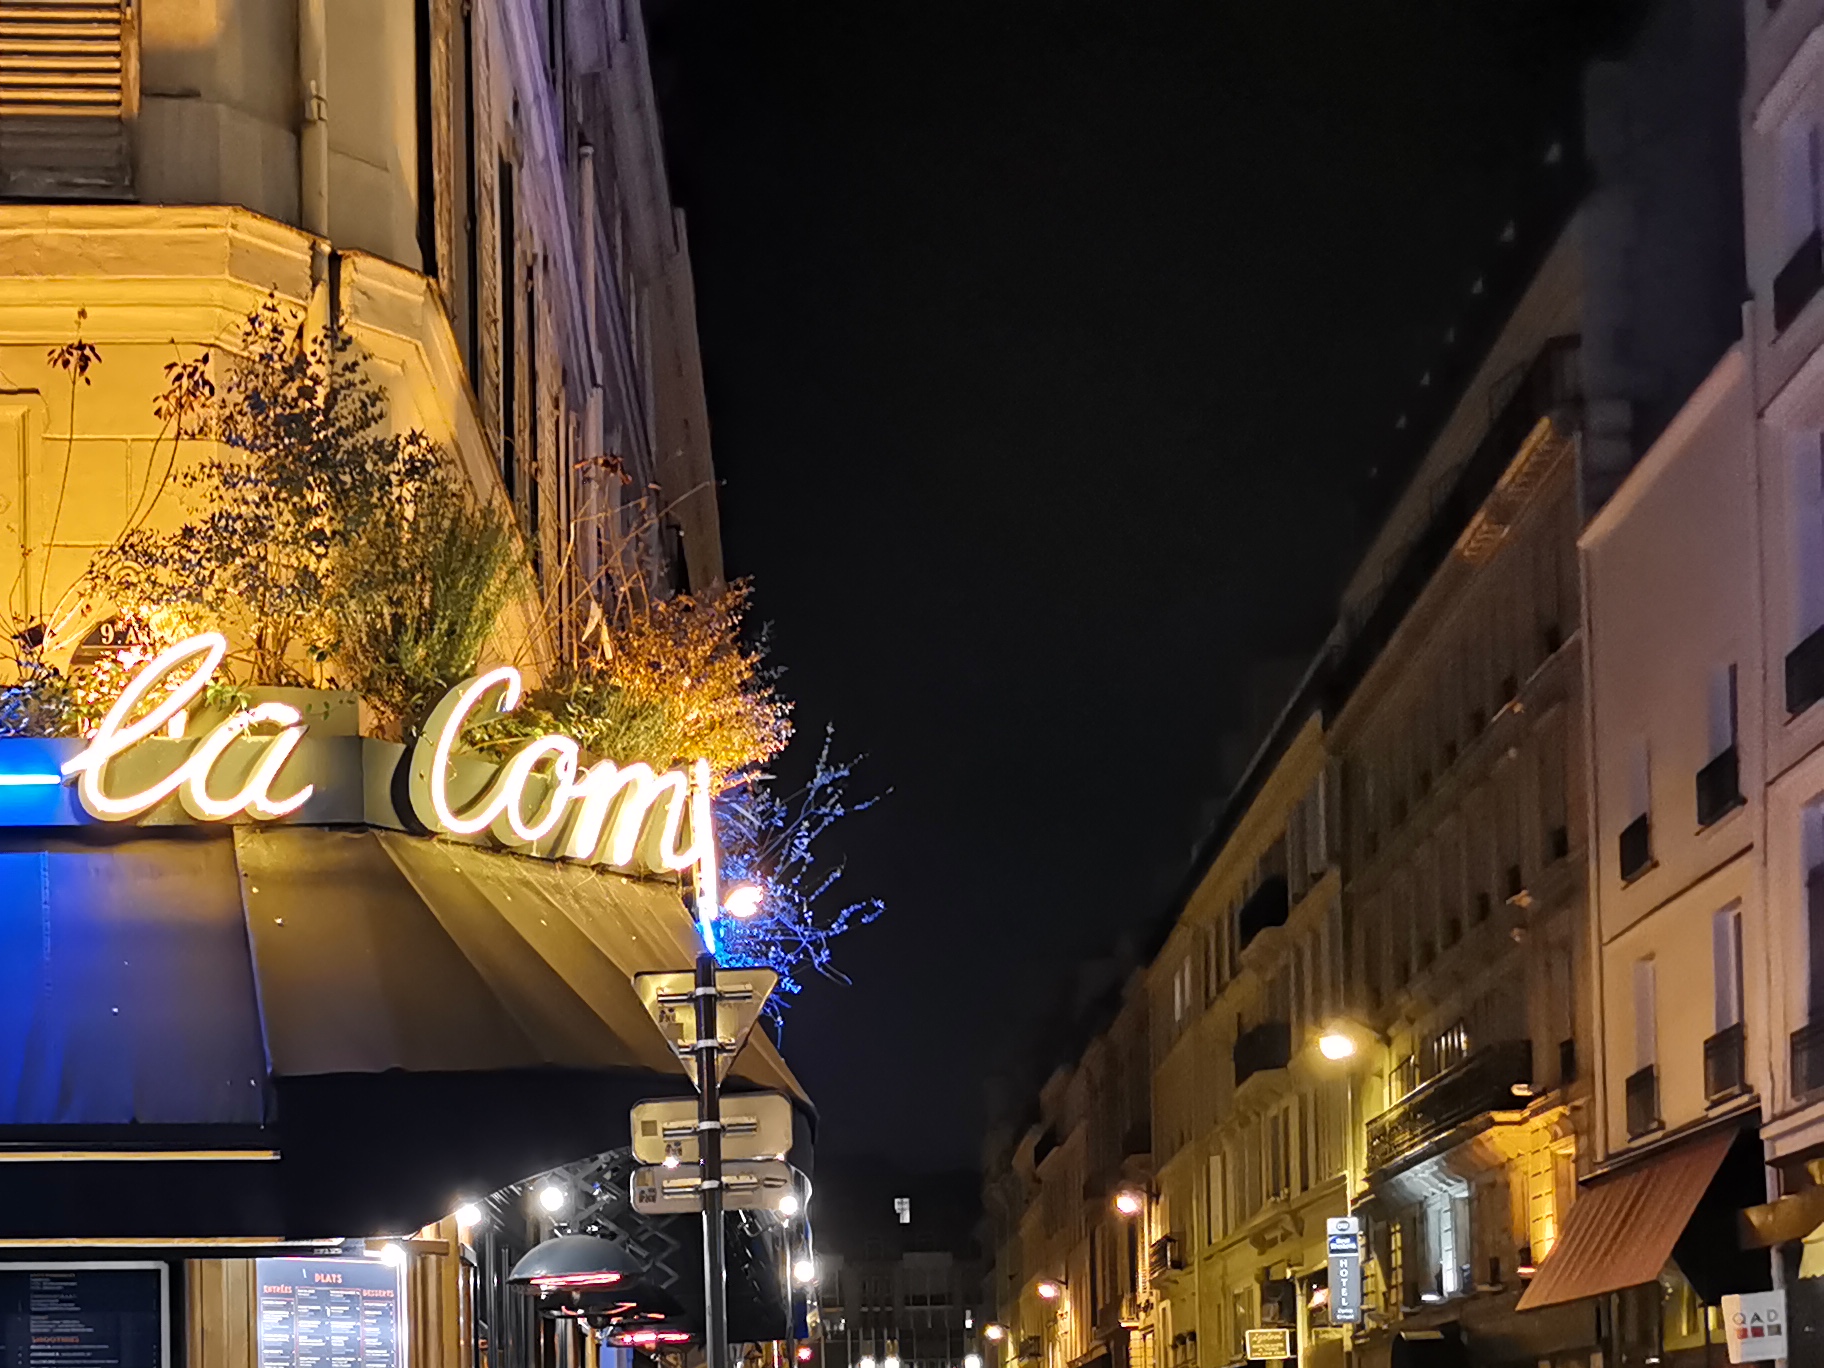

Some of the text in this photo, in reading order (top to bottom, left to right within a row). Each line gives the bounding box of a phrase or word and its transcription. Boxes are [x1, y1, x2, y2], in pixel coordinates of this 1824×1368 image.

[314, 1273, 343, 1284] PLATS
[1339, 1258, 1350, 1307] HOTEL
[263, 1284, 293, 1294] ENTRÉES
[1732, 1308, 1779, 1326] QAD
